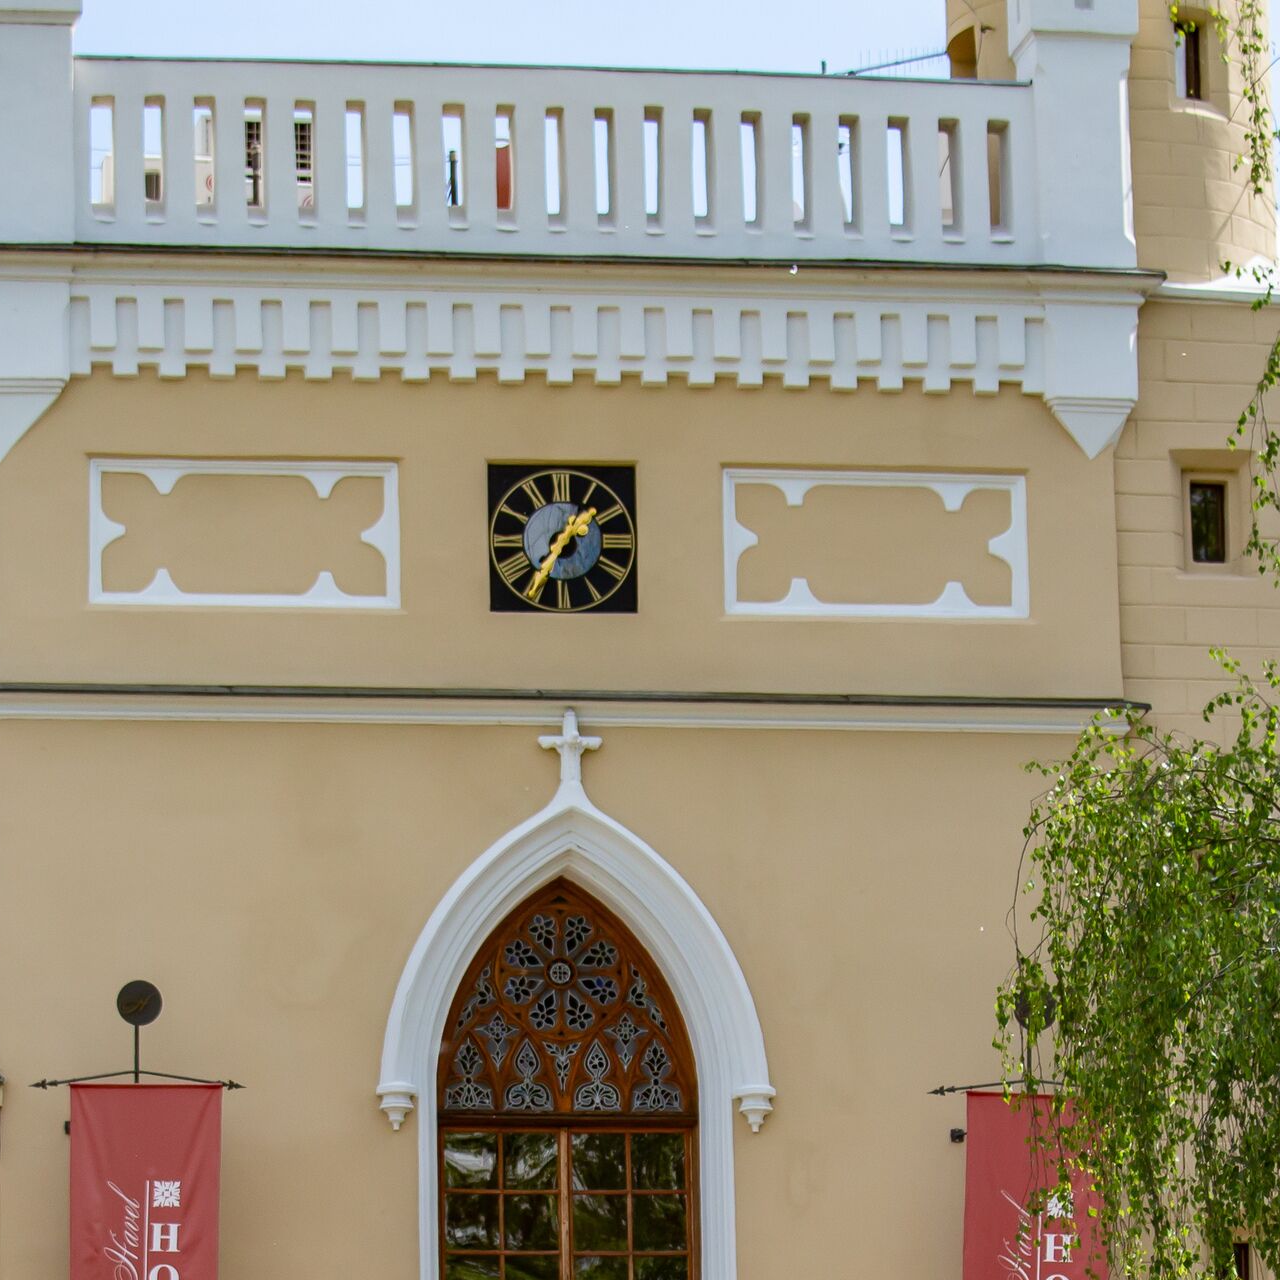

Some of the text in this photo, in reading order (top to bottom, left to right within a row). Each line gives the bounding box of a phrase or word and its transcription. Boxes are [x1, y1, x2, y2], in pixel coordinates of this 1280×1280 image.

[522, 479, 547, 509] XI
[552, 473, 570, 502] XII
[582, 481, 598, 504] I
[500, 504, 529, 524] X
[595, 504, 624, 525] II
[494, 533, 523, 547] IX
[603, 534, 632, 549] III
[557, 580, 572, 608] VI
[584, 575, 603, 601] V
